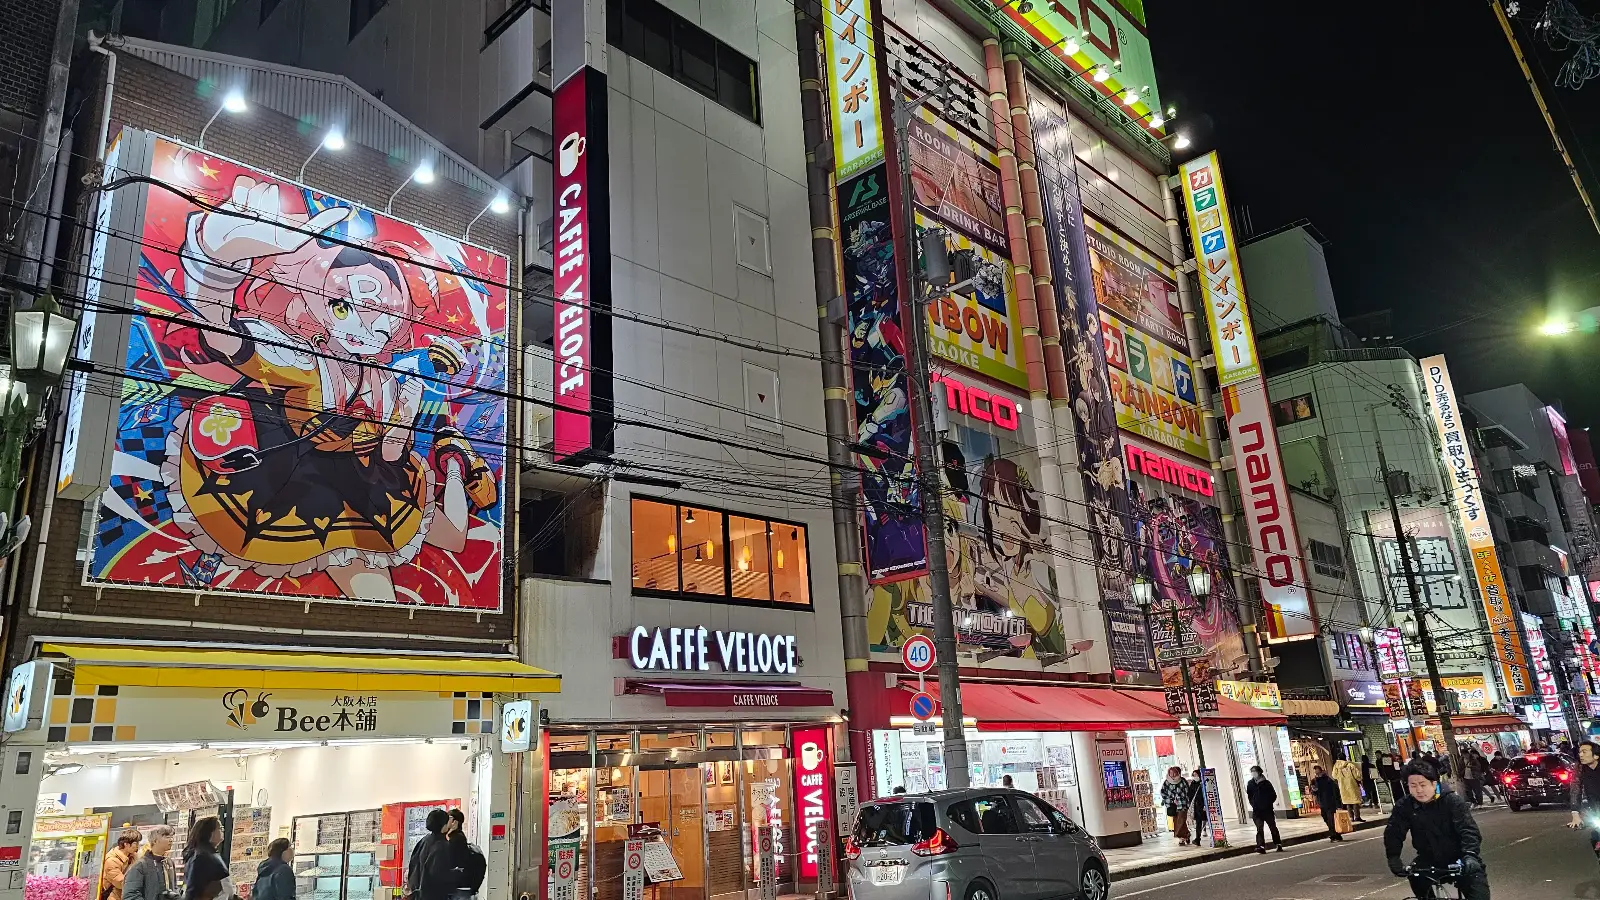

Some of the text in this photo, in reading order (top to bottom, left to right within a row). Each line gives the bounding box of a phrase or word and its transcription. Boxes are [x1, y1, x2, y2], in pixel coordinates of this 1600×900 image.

[915, 125, 951, 157] ROOM
[840, 150, 884, 177] KARAOKE
[943, 205, 1007, 249] DRINK BAR
[1086, 234, 1142, 276] STUDIO ROOM
[1190, 166, 1243, 365] カラオケ レインボー
[558, 182, 585, 396] CAFFÈ VELOCE
[1139, 314, 1189, 349] PARTY ROOM
[929, 337, 981, 370] RAOKE
[1102, 328, 1193, 396] カラオケ
[1110, 371, 1203, 438] RAINBOW
[1429, 366, 1456, 430] DVD売るなら
[1140, 424, 1185, 452] KARAOKE
[1124, 443, 1214, 497] namco
[1238, 421, 1294, 588] namco
[907, 604, 935, 626] THE
[630, 624, 797, 674] CAFFÈ VELOCE
[909, 645, 928, 663] 40
[331, 695, 378, 707] 大阪本店
[755, 694, 779, 707] VELOCE
[274, 707, 378, 732] Bee本舗
[558, 850, 574, 861] 駐禁
[627, 841, 643, 852] 駐禁
